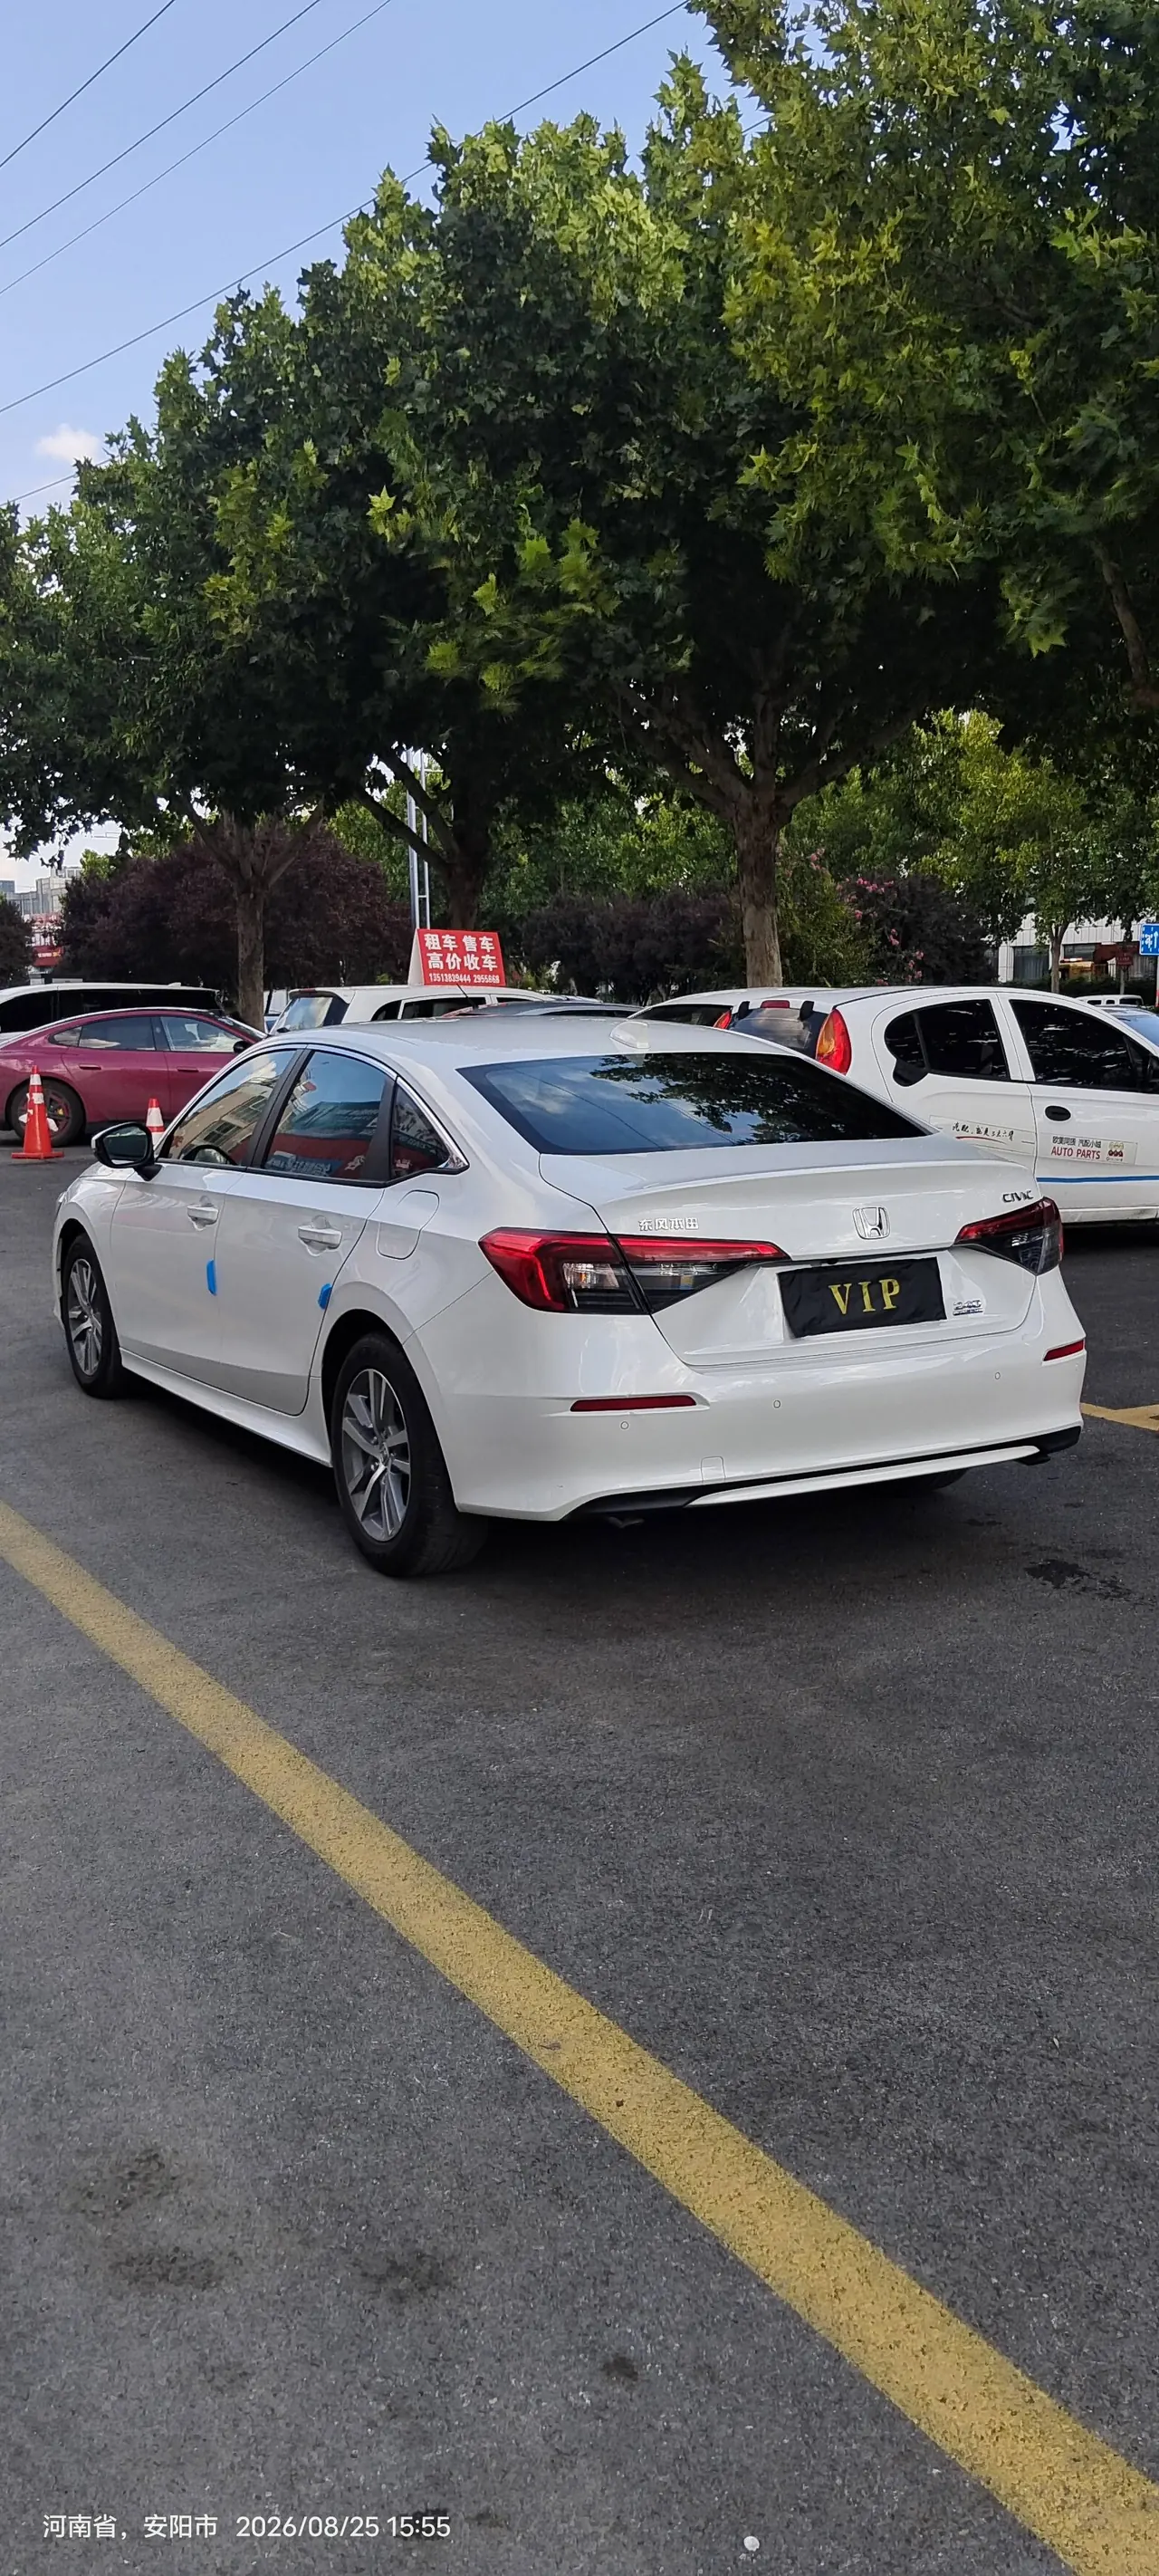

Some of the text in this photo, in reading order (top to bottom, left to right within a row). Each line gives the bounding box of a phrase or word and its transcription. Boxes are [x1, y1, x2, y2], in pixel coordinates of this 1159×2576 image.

[424, 933, 495, 953] 租车 售车
[426, 952, 498, 971] 高价收车
[1051, 1146, 1074, 1158] AUTO
[1076, 1148, 1101, 1160] PARTS
[638, 1217, 699, 1232] 东风本田
[828, 1278, 901, 1315] VIP
